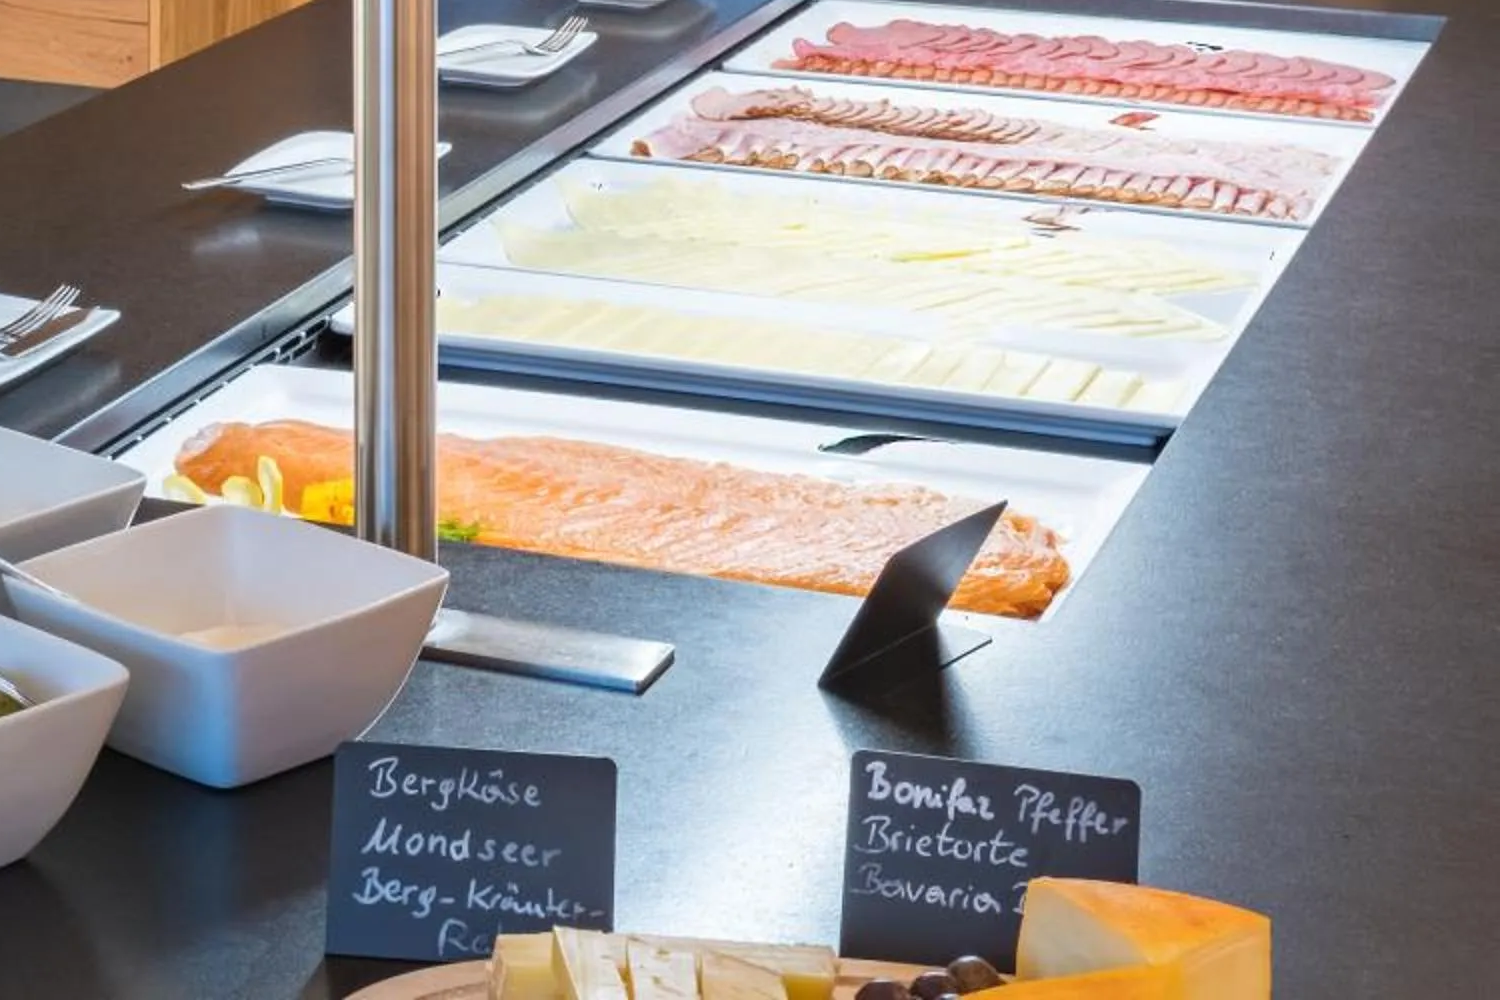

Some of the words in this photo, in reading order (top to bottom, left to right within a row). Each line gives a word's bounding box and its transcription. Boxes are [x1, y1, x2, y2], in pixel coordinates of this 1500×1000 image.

[1014, 783, 1129, 843] Pfeffer
[360, 817, 562, 867] Mondseer
[855, 815, 1028, 866] Brietorte
[850, 862, 1001, 914] Bavaria
